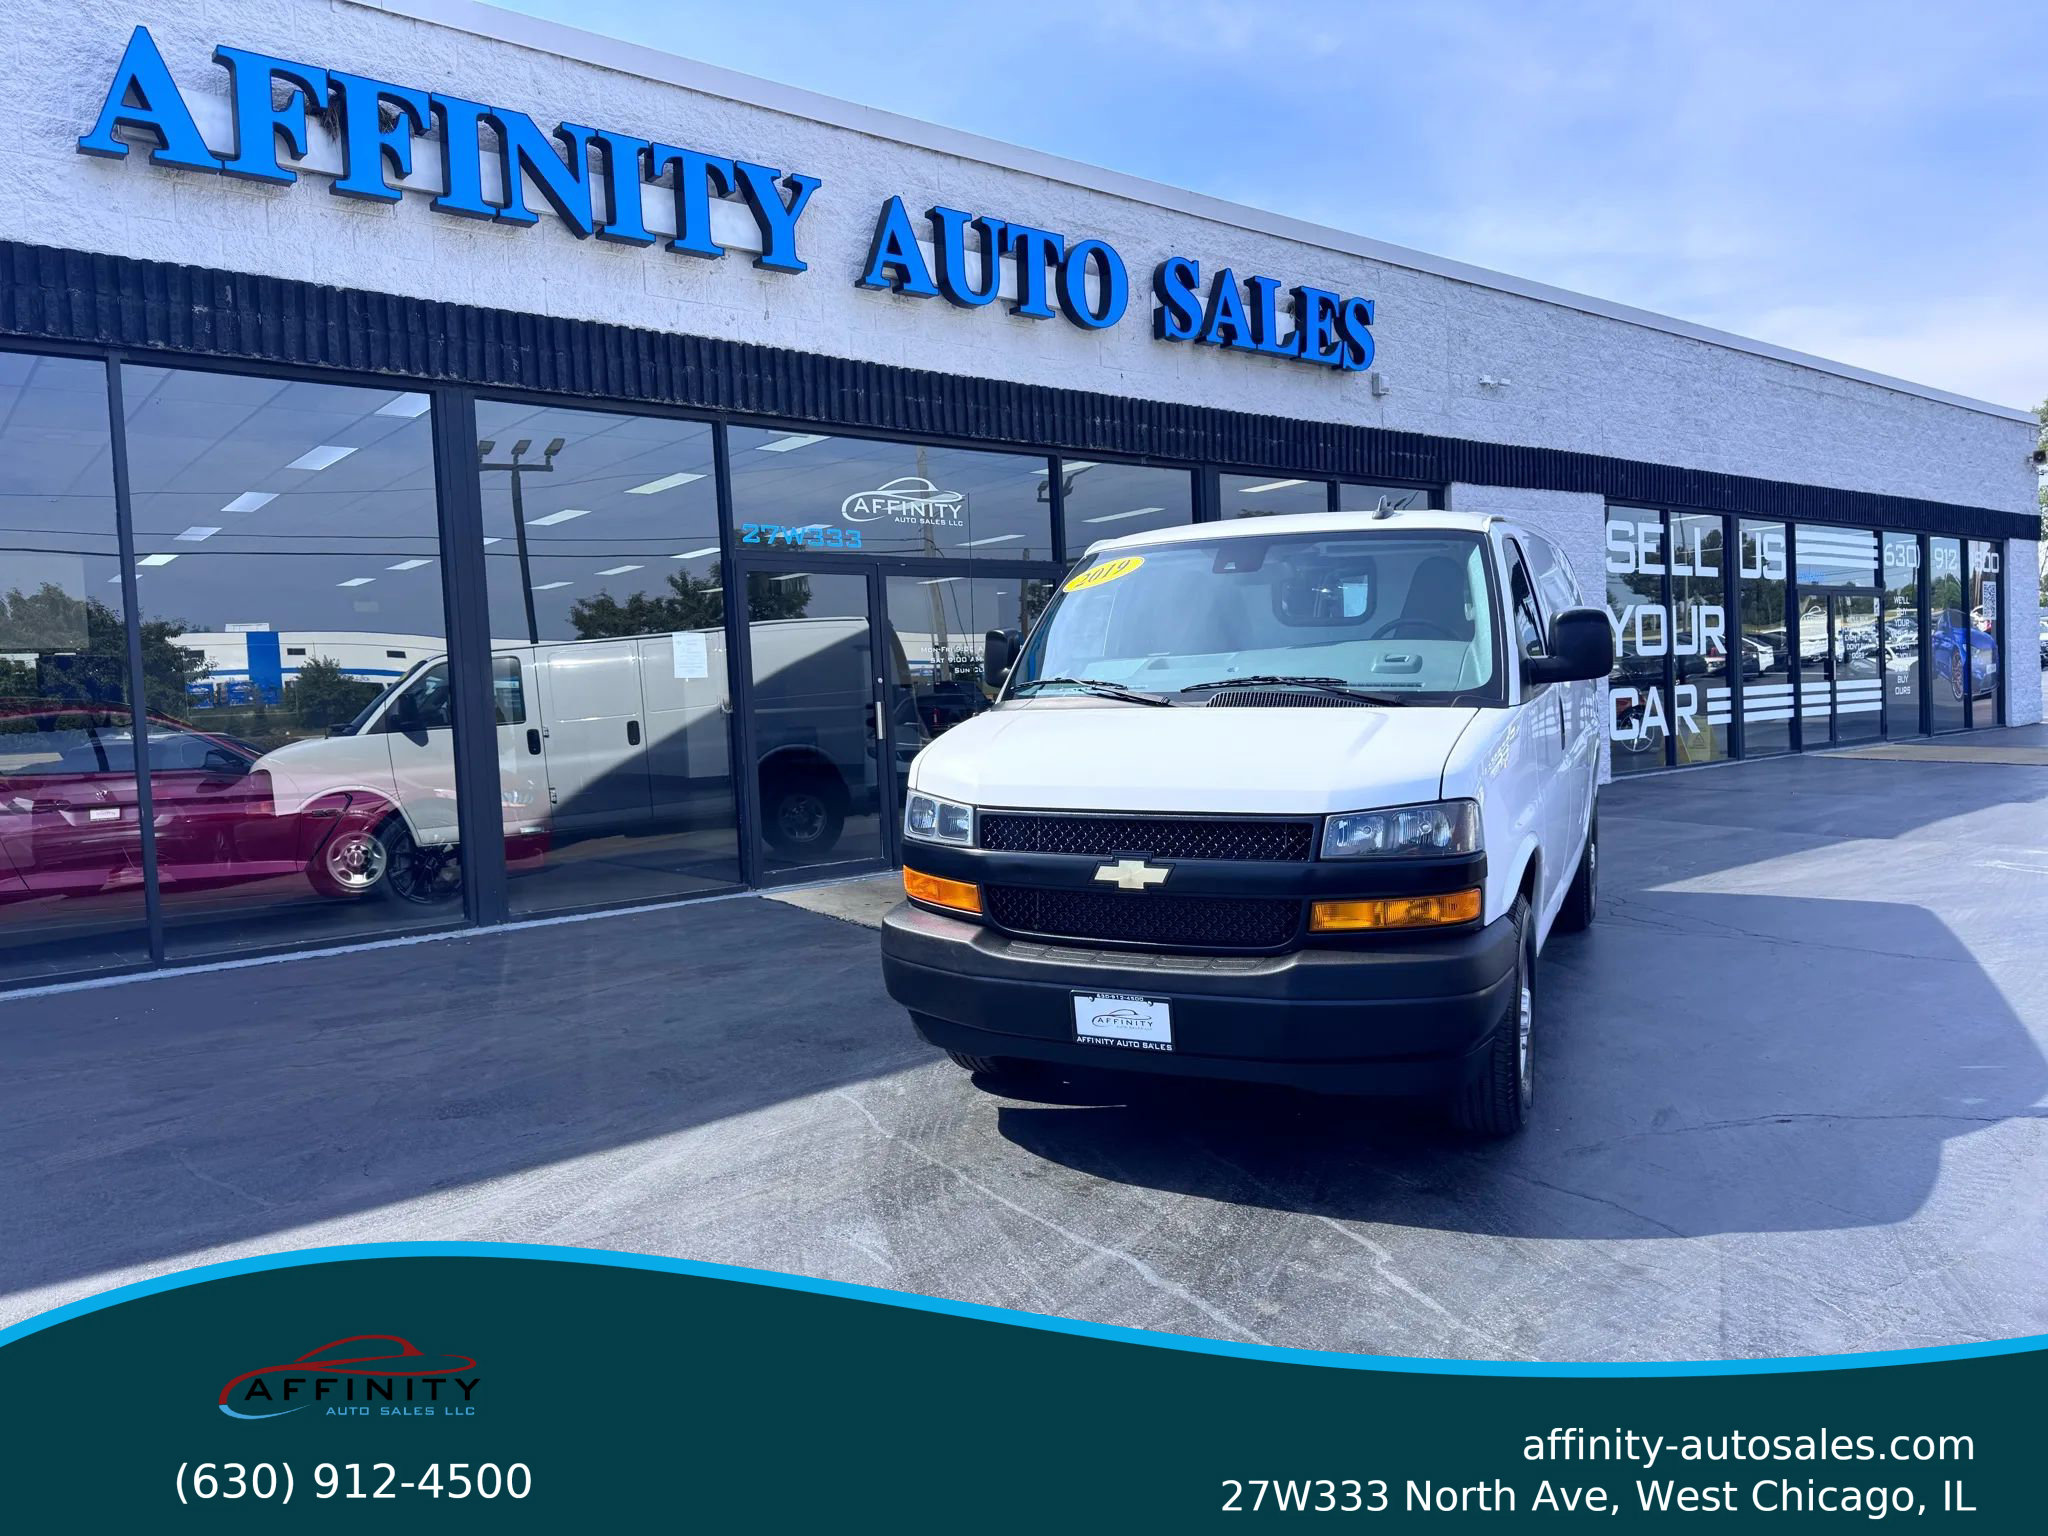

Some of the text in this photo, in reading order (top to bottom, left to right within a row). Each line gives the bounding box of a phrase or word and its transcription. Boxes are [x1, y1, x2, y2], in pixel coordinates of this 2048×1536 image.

[77, 25, 1377, 372] AFFINITY AUTO SALES
[853, 497, 963, 520] AFFINITY
[894, 516, 965, 528] AUTO SALES LLC
[741, 523, 862, 549] 27W333
[1605, 519, 1787, 580] SELL US
[1934, 547, 1958, 570] 912
[1073, 560, 1131, 588] 2019
[1602, 604, 1728, 657] YOUR
[1894, 686, 1911, 695] OURS
[1897, 675, 1909, 684] BUY
[1608, 683, 1701, 741] CAR
[1097, 1017, 1153, 1028] AFFINITY
[1076, 1035, 1173, 1051] AFFINITY AUTO SALES
